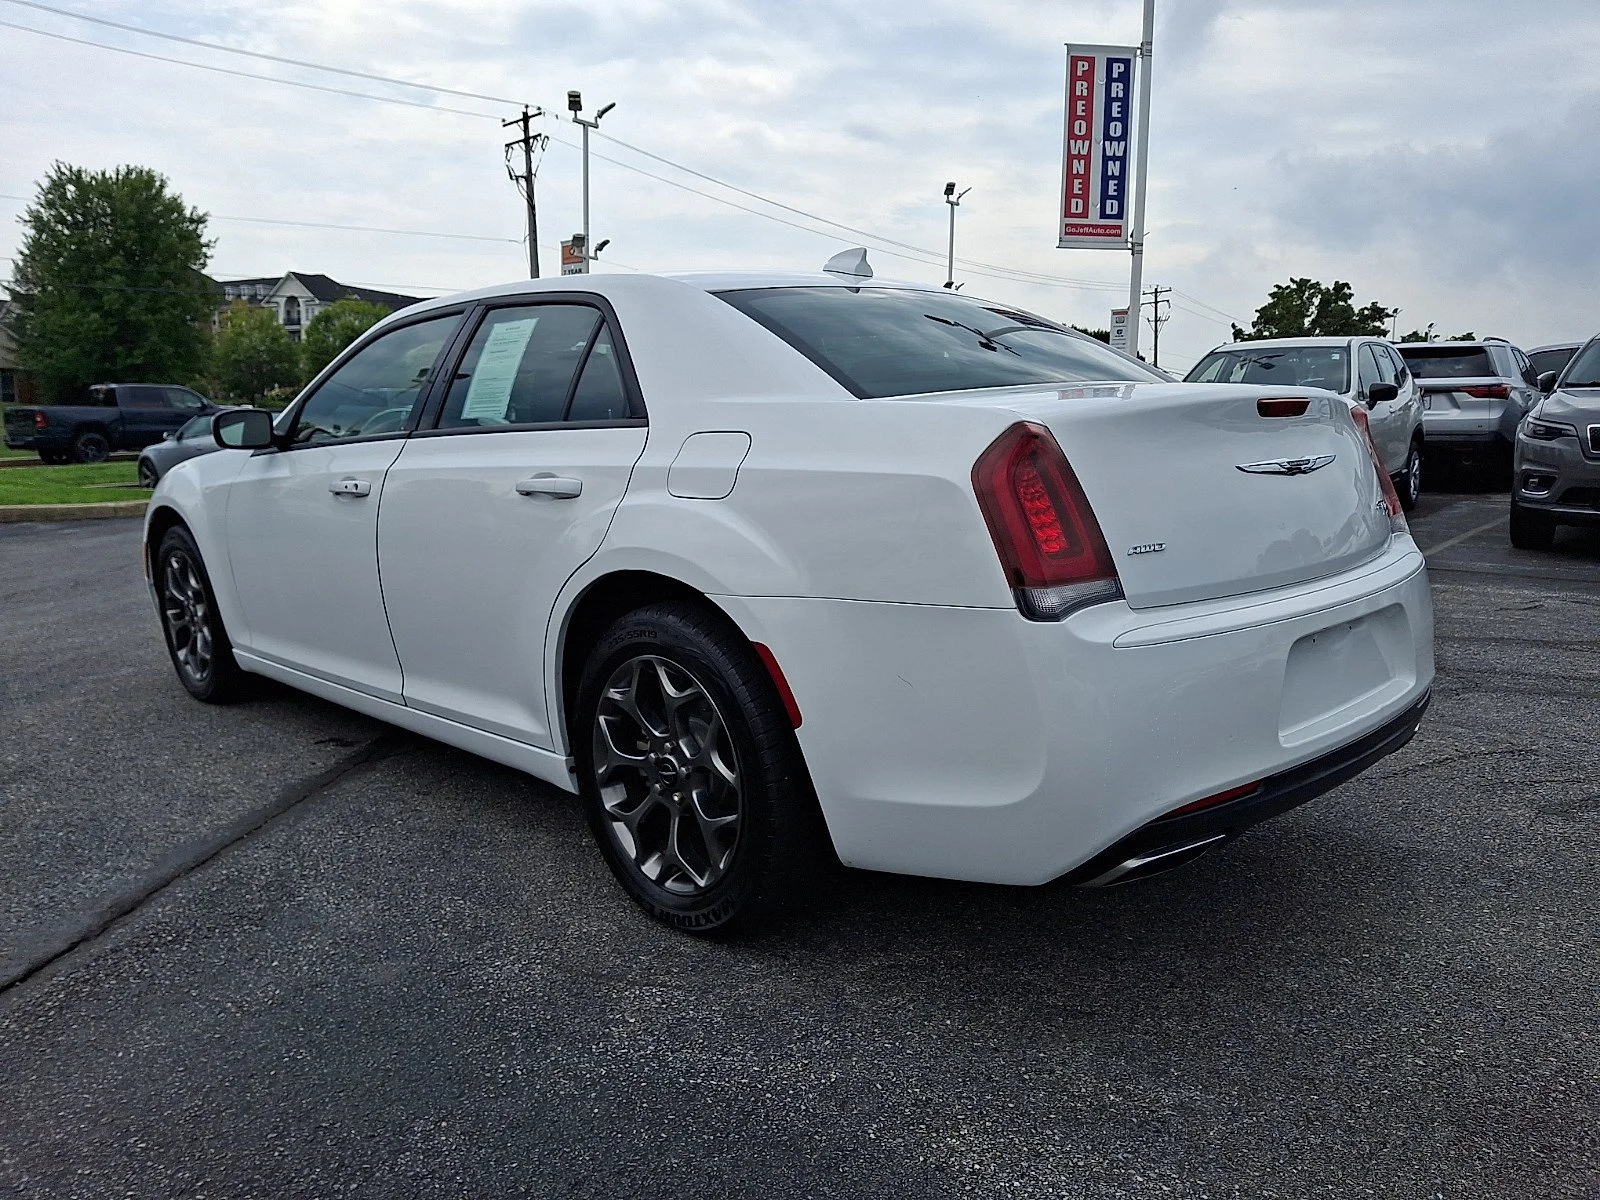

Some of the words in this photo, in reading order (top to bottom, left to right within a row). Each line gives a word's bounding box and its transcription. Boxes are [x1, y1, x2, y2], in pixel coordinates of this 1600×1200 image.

[1069, 60, 1090, 214] PREOWNED
[1104, 62, 1126, 215] PREOWNED
[1065, 226, 1121, 235] GoJeffAuto.com
